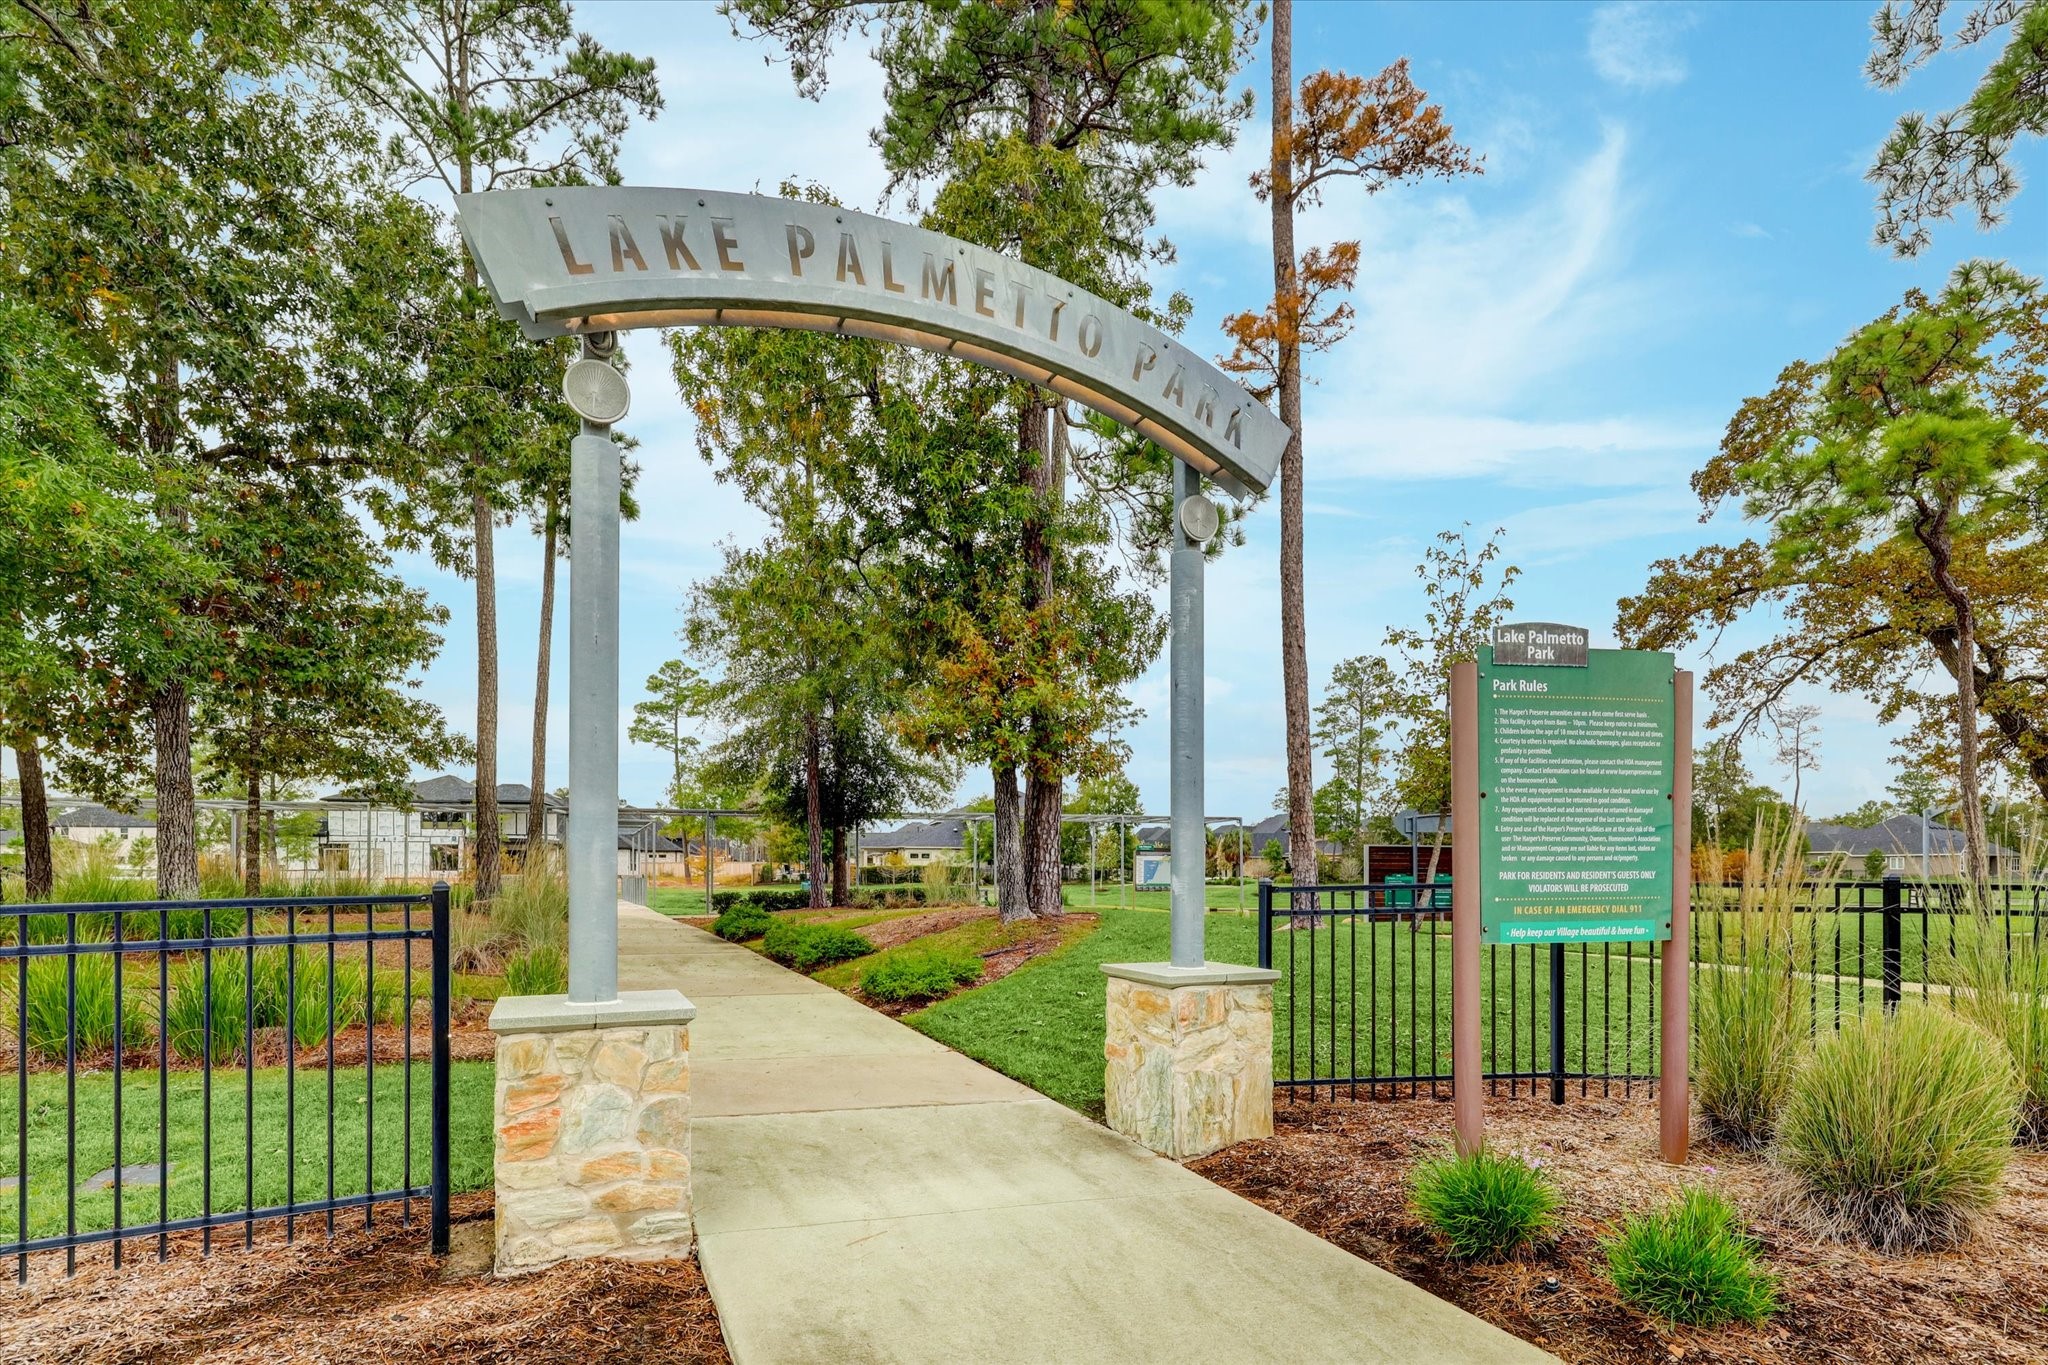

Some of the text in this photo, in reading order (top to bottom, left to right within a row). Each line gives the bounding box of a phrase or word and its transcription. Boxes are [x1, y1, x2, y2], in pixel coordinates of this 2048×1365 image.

[549, 214, 1244, 448] LAKE PALMETTO PARK
[1498, 630, 1584, 645] Lake Palmetto
[1528, 646, 1554, 660] Park
[1493, 679, 1547, 692] Park Rules
[1509, 709, 1528, 717] Harper's
[1500, 872, 1516, 880] PARK
[1582, 871, 1616, 879] RESIDENT'S
[1641, 871, 1656, 879] ONLY
[1529, 884, 1628, 892] VIOLATORS WILL BE PROSECUTED
[1514, 906, 1522, 914] IN
[1525, 906, 1542, 914] CASE
[1544, 906, 1552, 914] OF
[1568, 905, 1610, 914] EMERGENCY
[1510, 929, 1525, 938] Help
[1527, 928, 1542, 938] keep
[1557, 927, 1578, 938] Village
[1580, 926, 1610, 935] beautiful
[1611, 926, 1616, 934] &
[1618, 926, 1632, 934] have
[1634, 926, 1645, 934] fun
